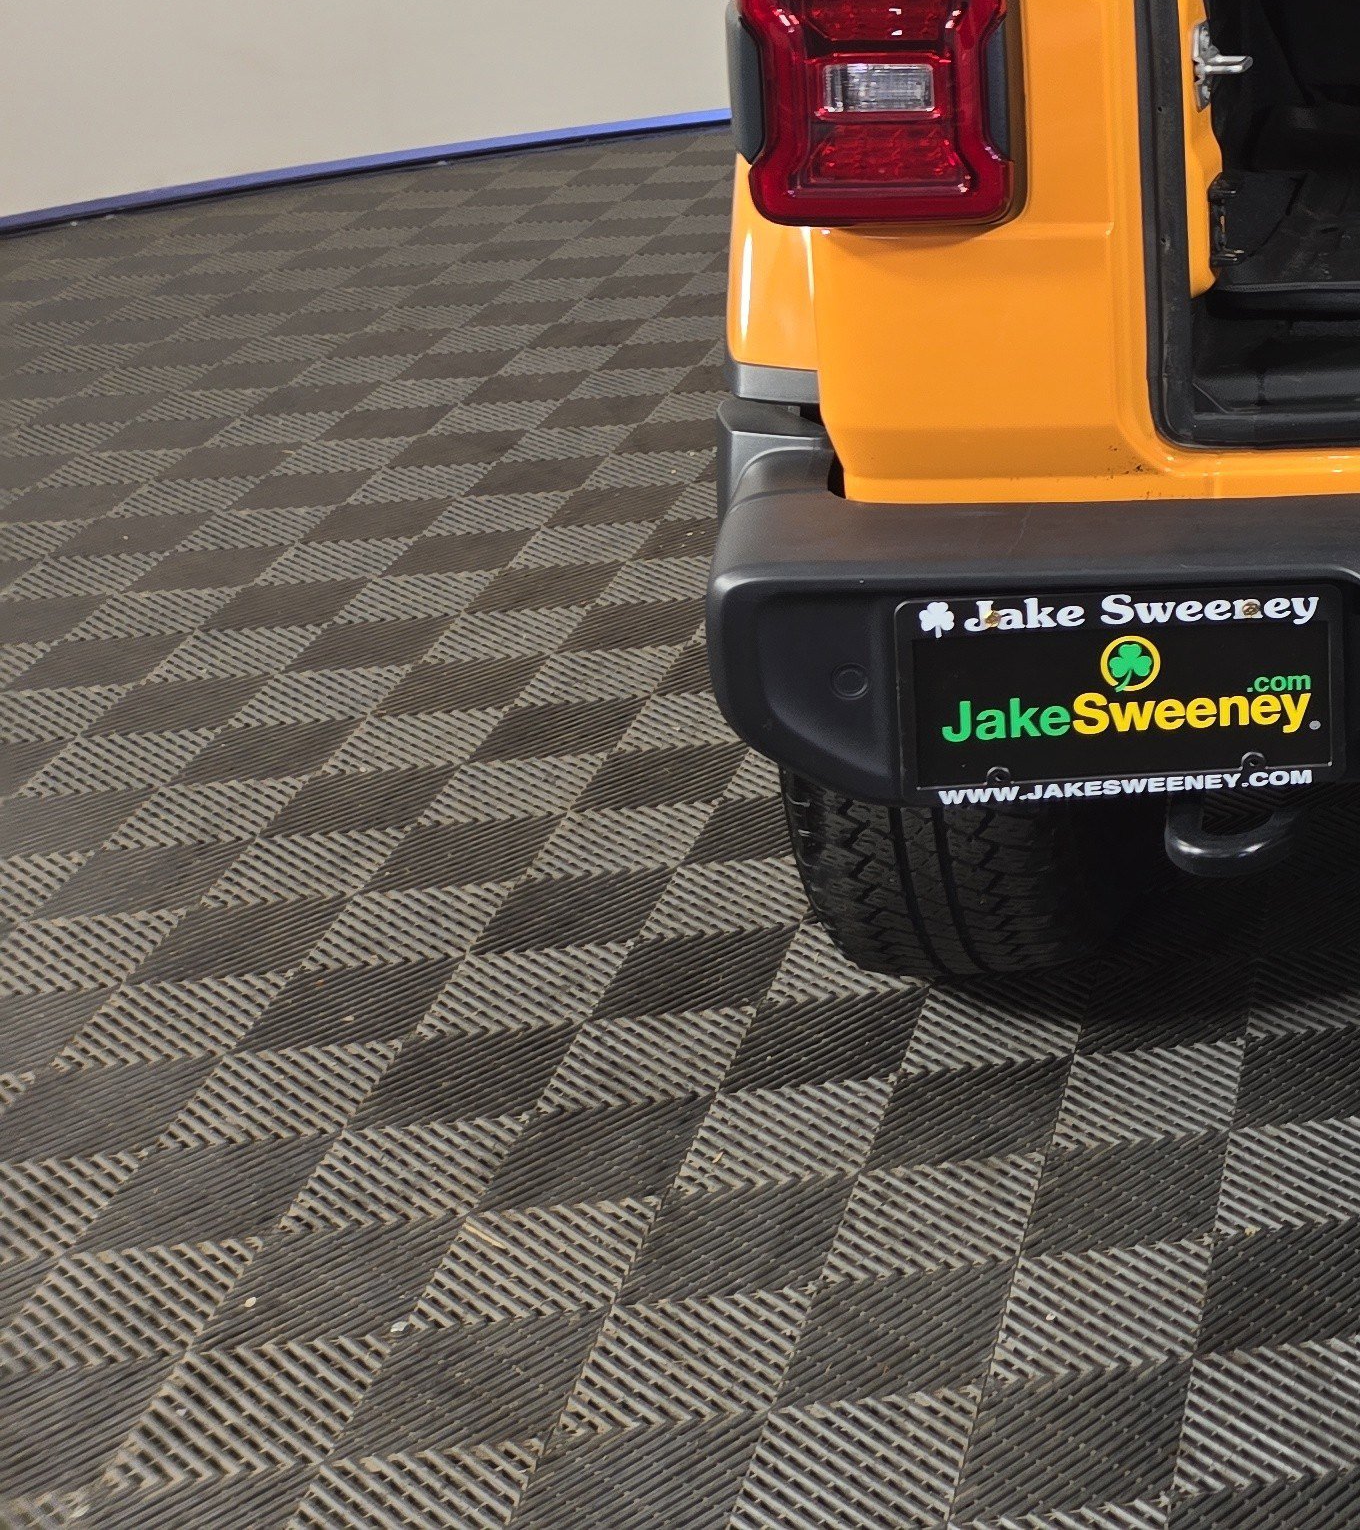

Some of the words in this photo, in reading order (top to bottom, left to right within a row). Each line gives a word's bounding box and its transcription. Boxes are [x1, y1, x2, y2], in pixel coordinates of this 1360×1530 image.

[963, 597, 1086, 632] Jake
[1100, 594, 1320, 626] Sweeney
[1247, 672, 1312, 693] .com
[942, 692, 1312, 743] JakeSweeney
[938, 770, 1313, 806] WWW.JAKESWEENEY.COM
